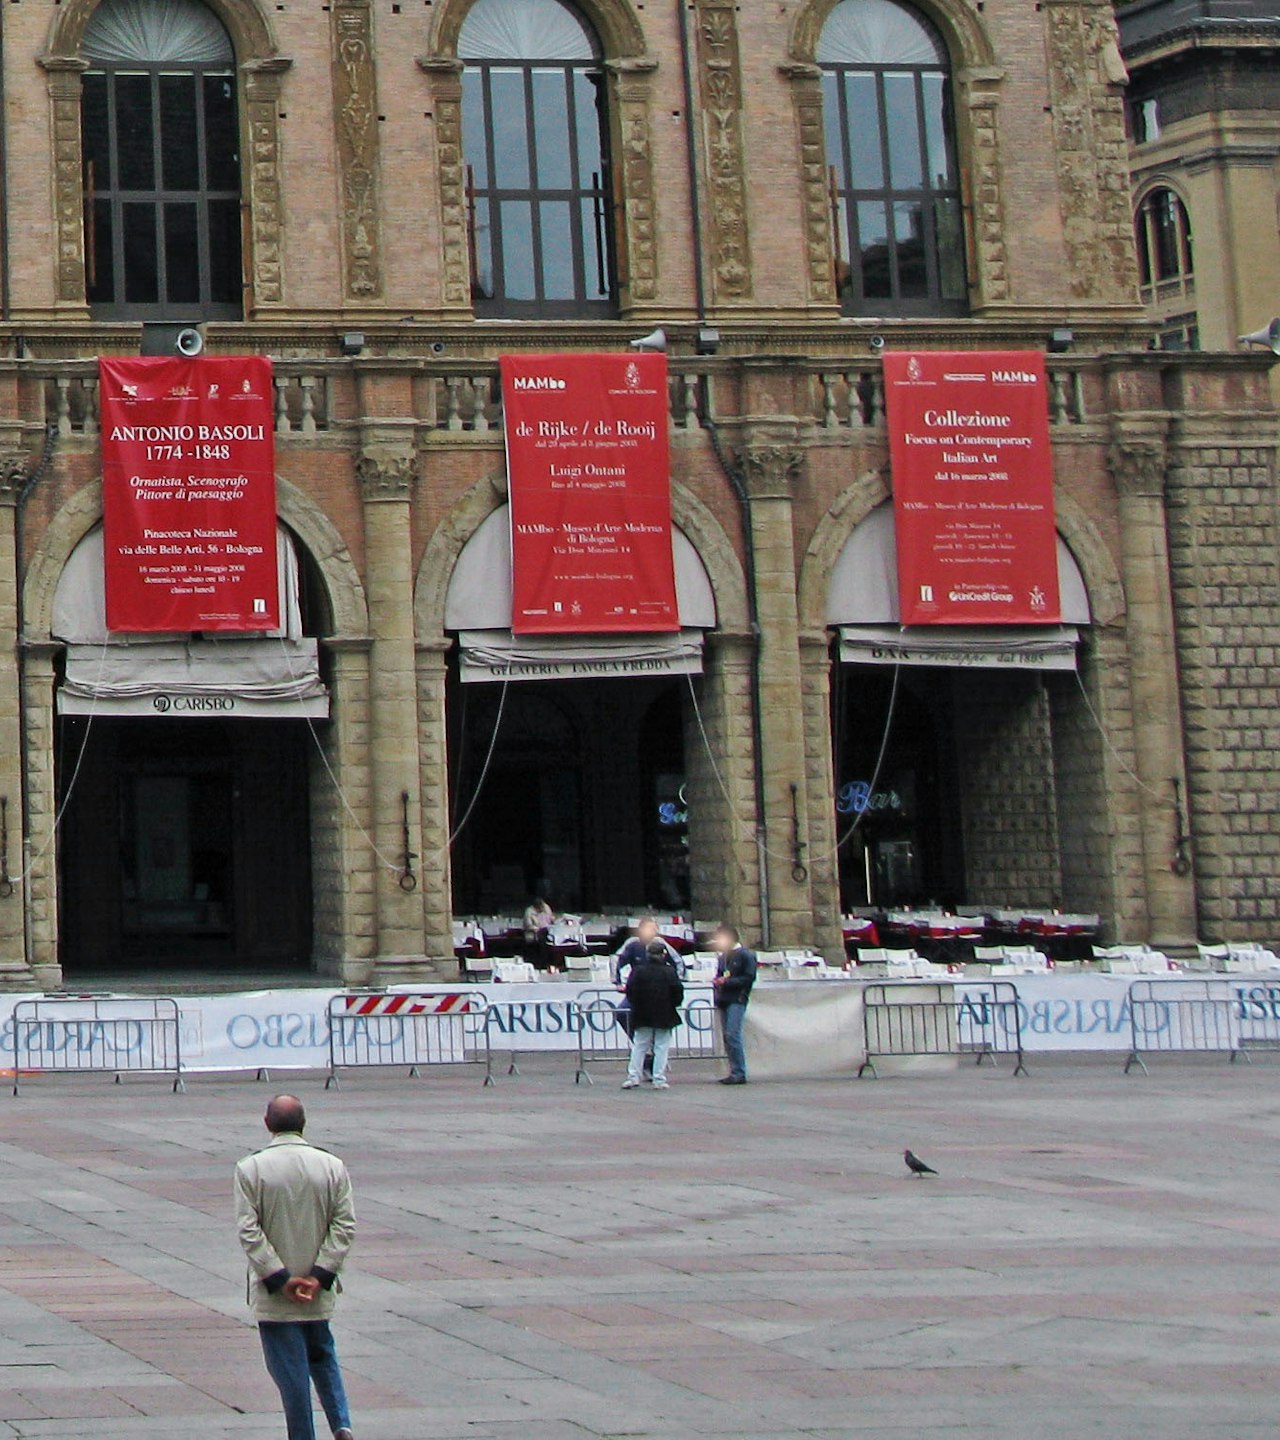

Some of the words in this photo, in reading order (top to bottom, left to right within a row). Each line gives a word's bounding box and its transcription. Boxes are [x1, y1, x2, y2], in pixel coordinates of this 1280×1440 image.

[514, 377, 566, 389] MAMbo
[991, 371, 1037, 382] MAMbo
[924, 410, 1011, 427] Collezione
[110, 426, 194, 441] ANTONIO
[198, 425, 264, 440] BASOLI
[516, 422, 534, 437] de
[539, 421, 578, 441] Rijke
[594, 421, 612, 435] de
[617, 421, 656, 440] Rooij
[905, 433, 937, 444] Focus
[940, 435, 954, 444] on
[956, 434, 1032, 448] Contemporary
[943, 452, 978, 463] Italian
[980, 452, 998, 463] Art
[550, 464, 581, 478] Luigi
[585, 464, 626, 475] Ontani
[135, 489, 173, 500] Pittore
[175, 488, 186, 499] di
[188, 488, 244, 501] paesaggio
[144, 529, 191, 538] Pinacoteca
[193, 529, 237, 538] Nazionale
[567, 535, 577, 543] di
[579, 534, 615, 544] Bologna
[119, 546, 133, 554] via
[135, 546, 157, 554] delle
[159, 546, 182, 554] Belle
[207, 545, 218, 553] 56
[226, 545, 263, 555] Bologna
[490, 663, 560, 675] GELATERIA
[572, 662, 619, 673] TAVOLA
[622, 659, 671, 671] FREDDA
[174, 697, 234, 711] CARISBO
